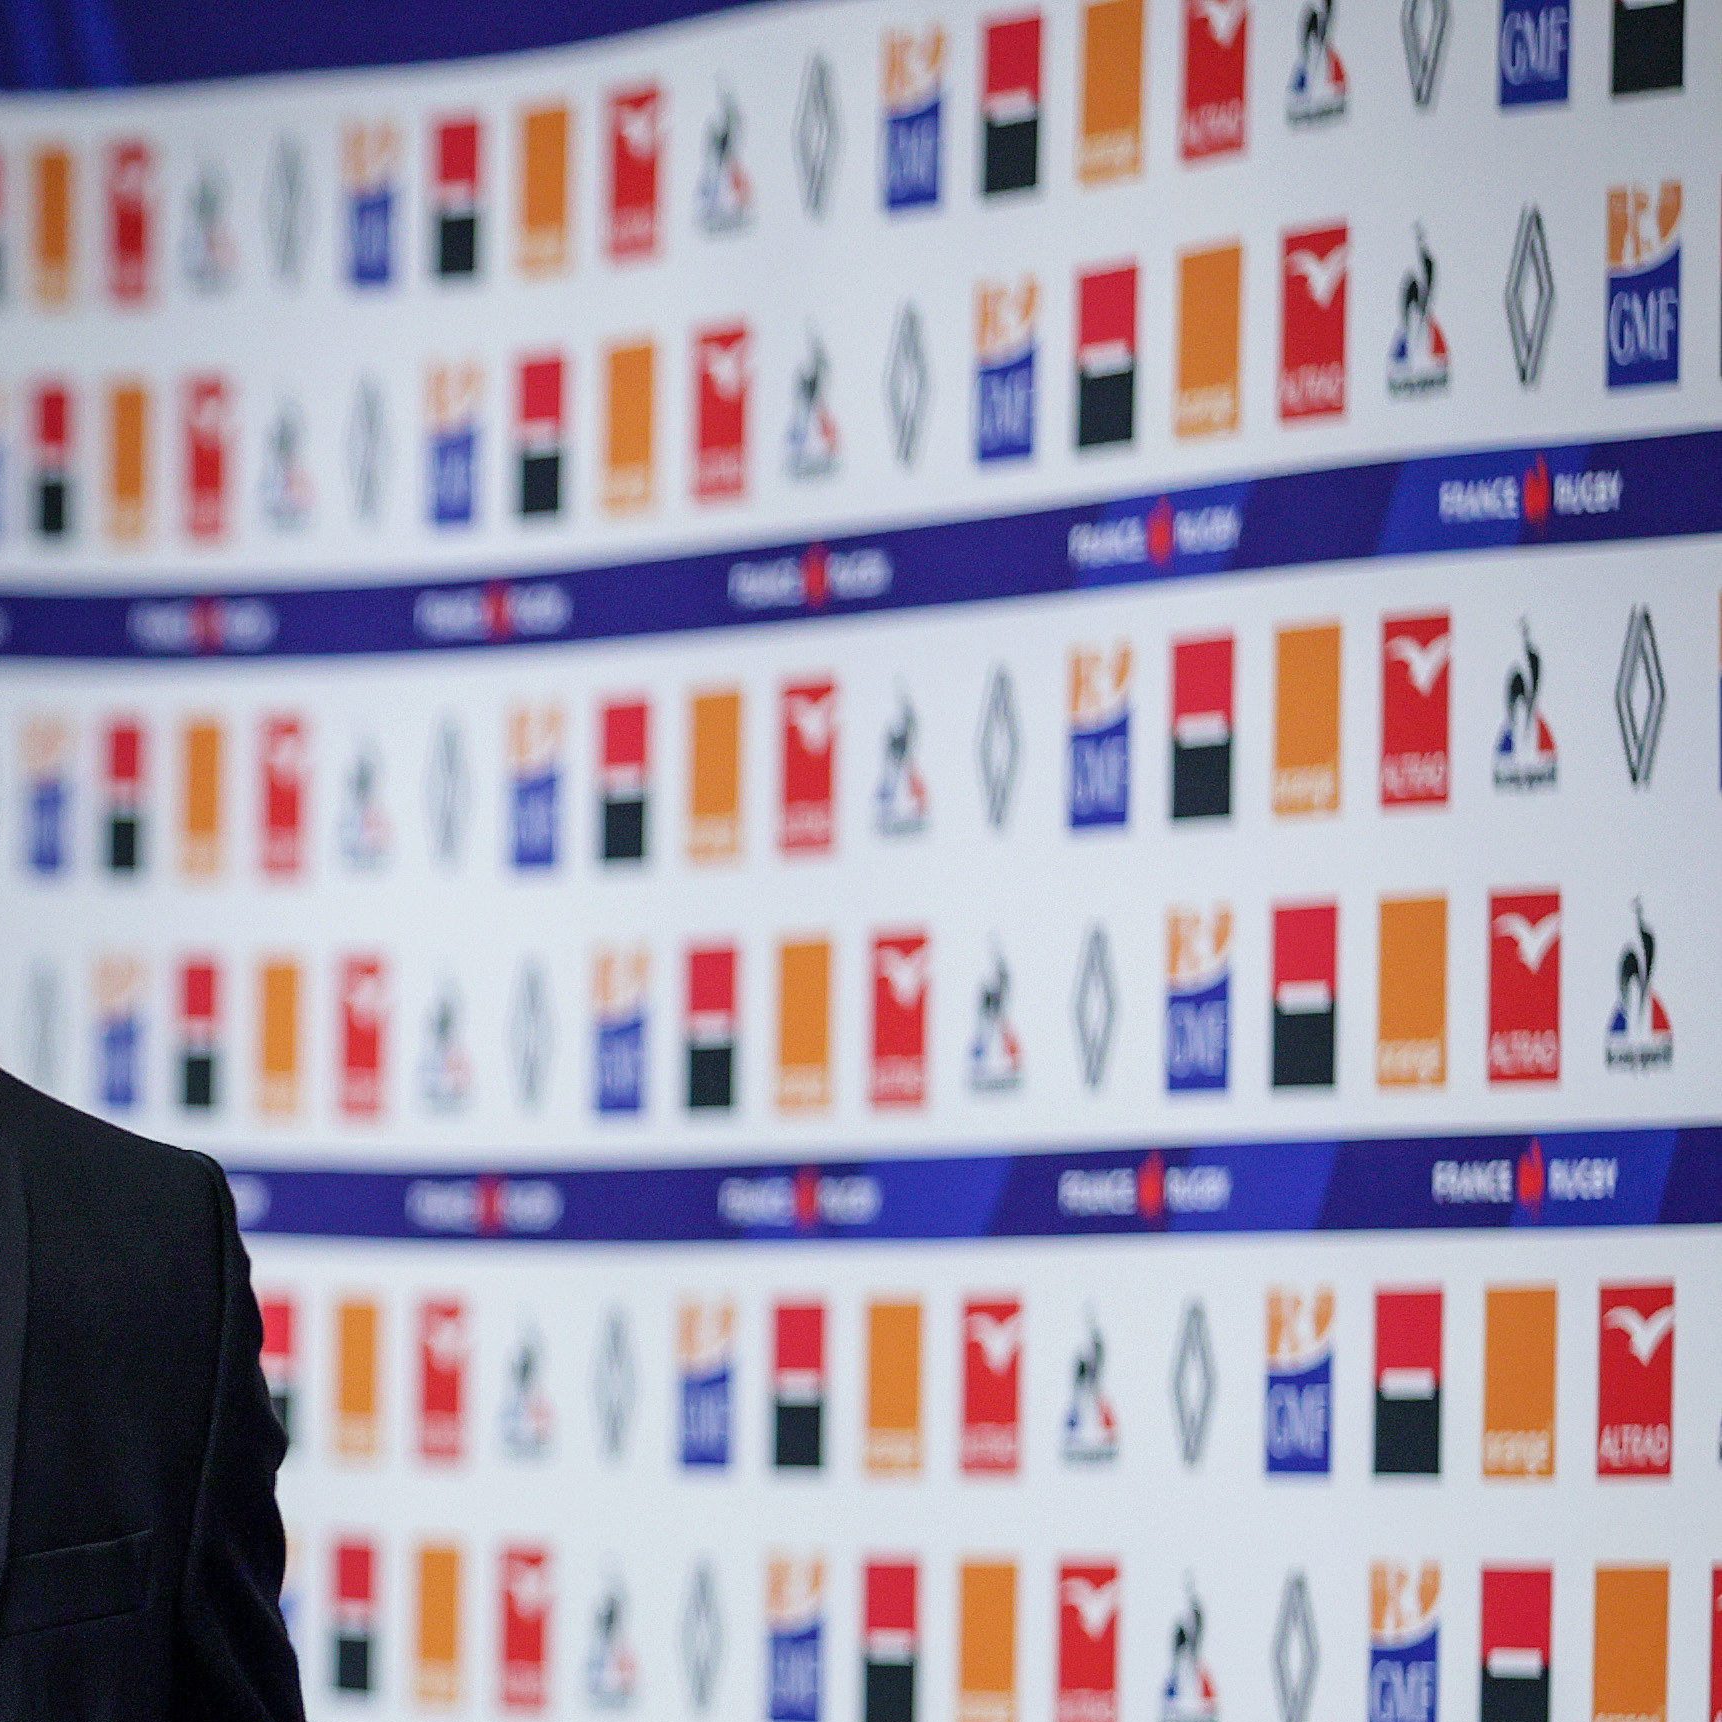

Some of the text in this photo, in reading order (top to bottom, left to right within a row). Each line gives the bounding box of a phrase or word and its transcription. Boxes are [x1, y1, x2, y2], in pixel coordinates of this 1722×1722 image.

[1500, 8, 1568, 85] GMF
[1609, 290, 1677, 366] GMF
[1438, 469, 1624, 523] FRANCE RUGBY
[1431, 1157, 1618, 1204] FRANCE RUGBY
[1485, 1428, 1550, 1474] orange
[1599, 1423, 1670, 1467] ALTRAD
